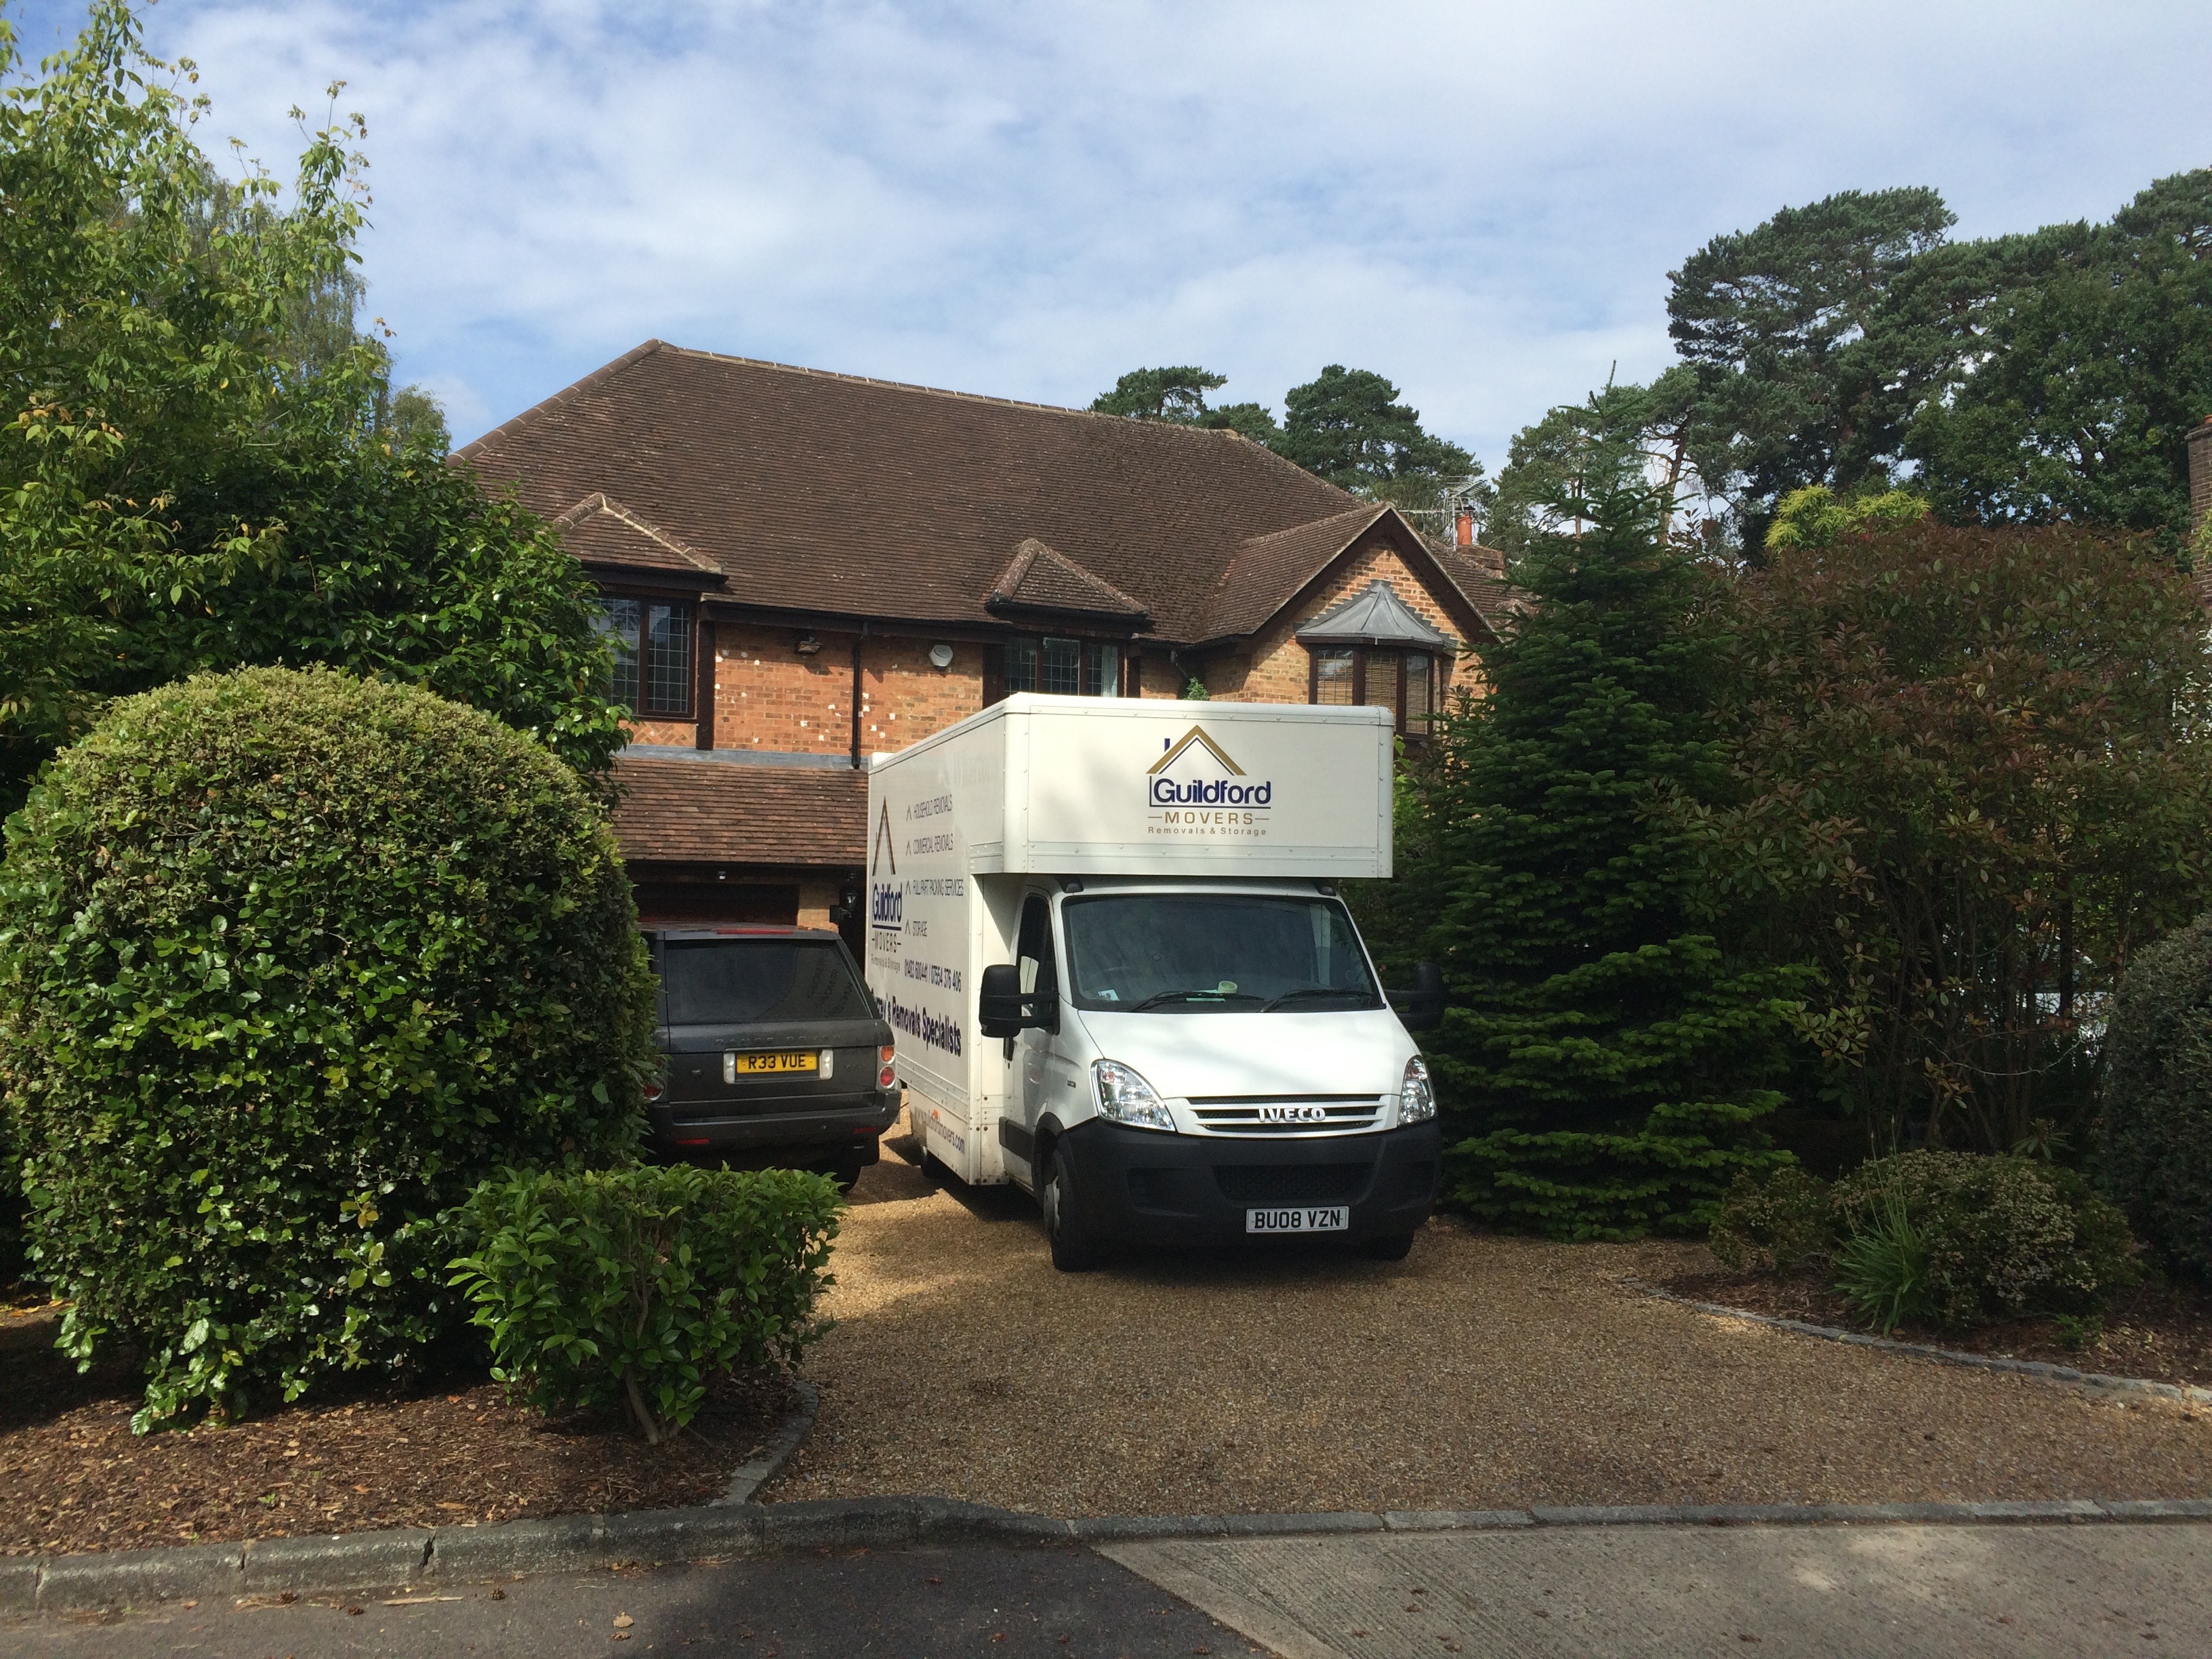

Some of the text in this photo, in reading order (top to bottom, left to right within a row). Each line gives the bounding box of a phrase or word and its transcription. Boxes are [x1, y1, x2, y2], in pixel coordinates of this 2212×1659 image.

[1153, 778, 1271, 804] Guildford
[934, 794, 953, 815] REMOVALS
[1165, 811, 1253, 825] MOVERS
[1148, 826, 1205, 834] Removals
[1221, 827, 1267, 837] Storage
[935, 833, 954, 852] REMOVALS
[945, 879, 964, 896] SERVICES
[874, 882, 903, 923] Guildford
[875, 931, 897, 953] MOVERS
[892, 995, 921, 1038] Removals
[922, 1006, 962, 1057] Specialists
[748, 1054, 806, 1069] R33 VUE
[1258, 1107, 1326, 1122] IVECO
[1254, 1210, 1340, 1229] BU08 VZN
